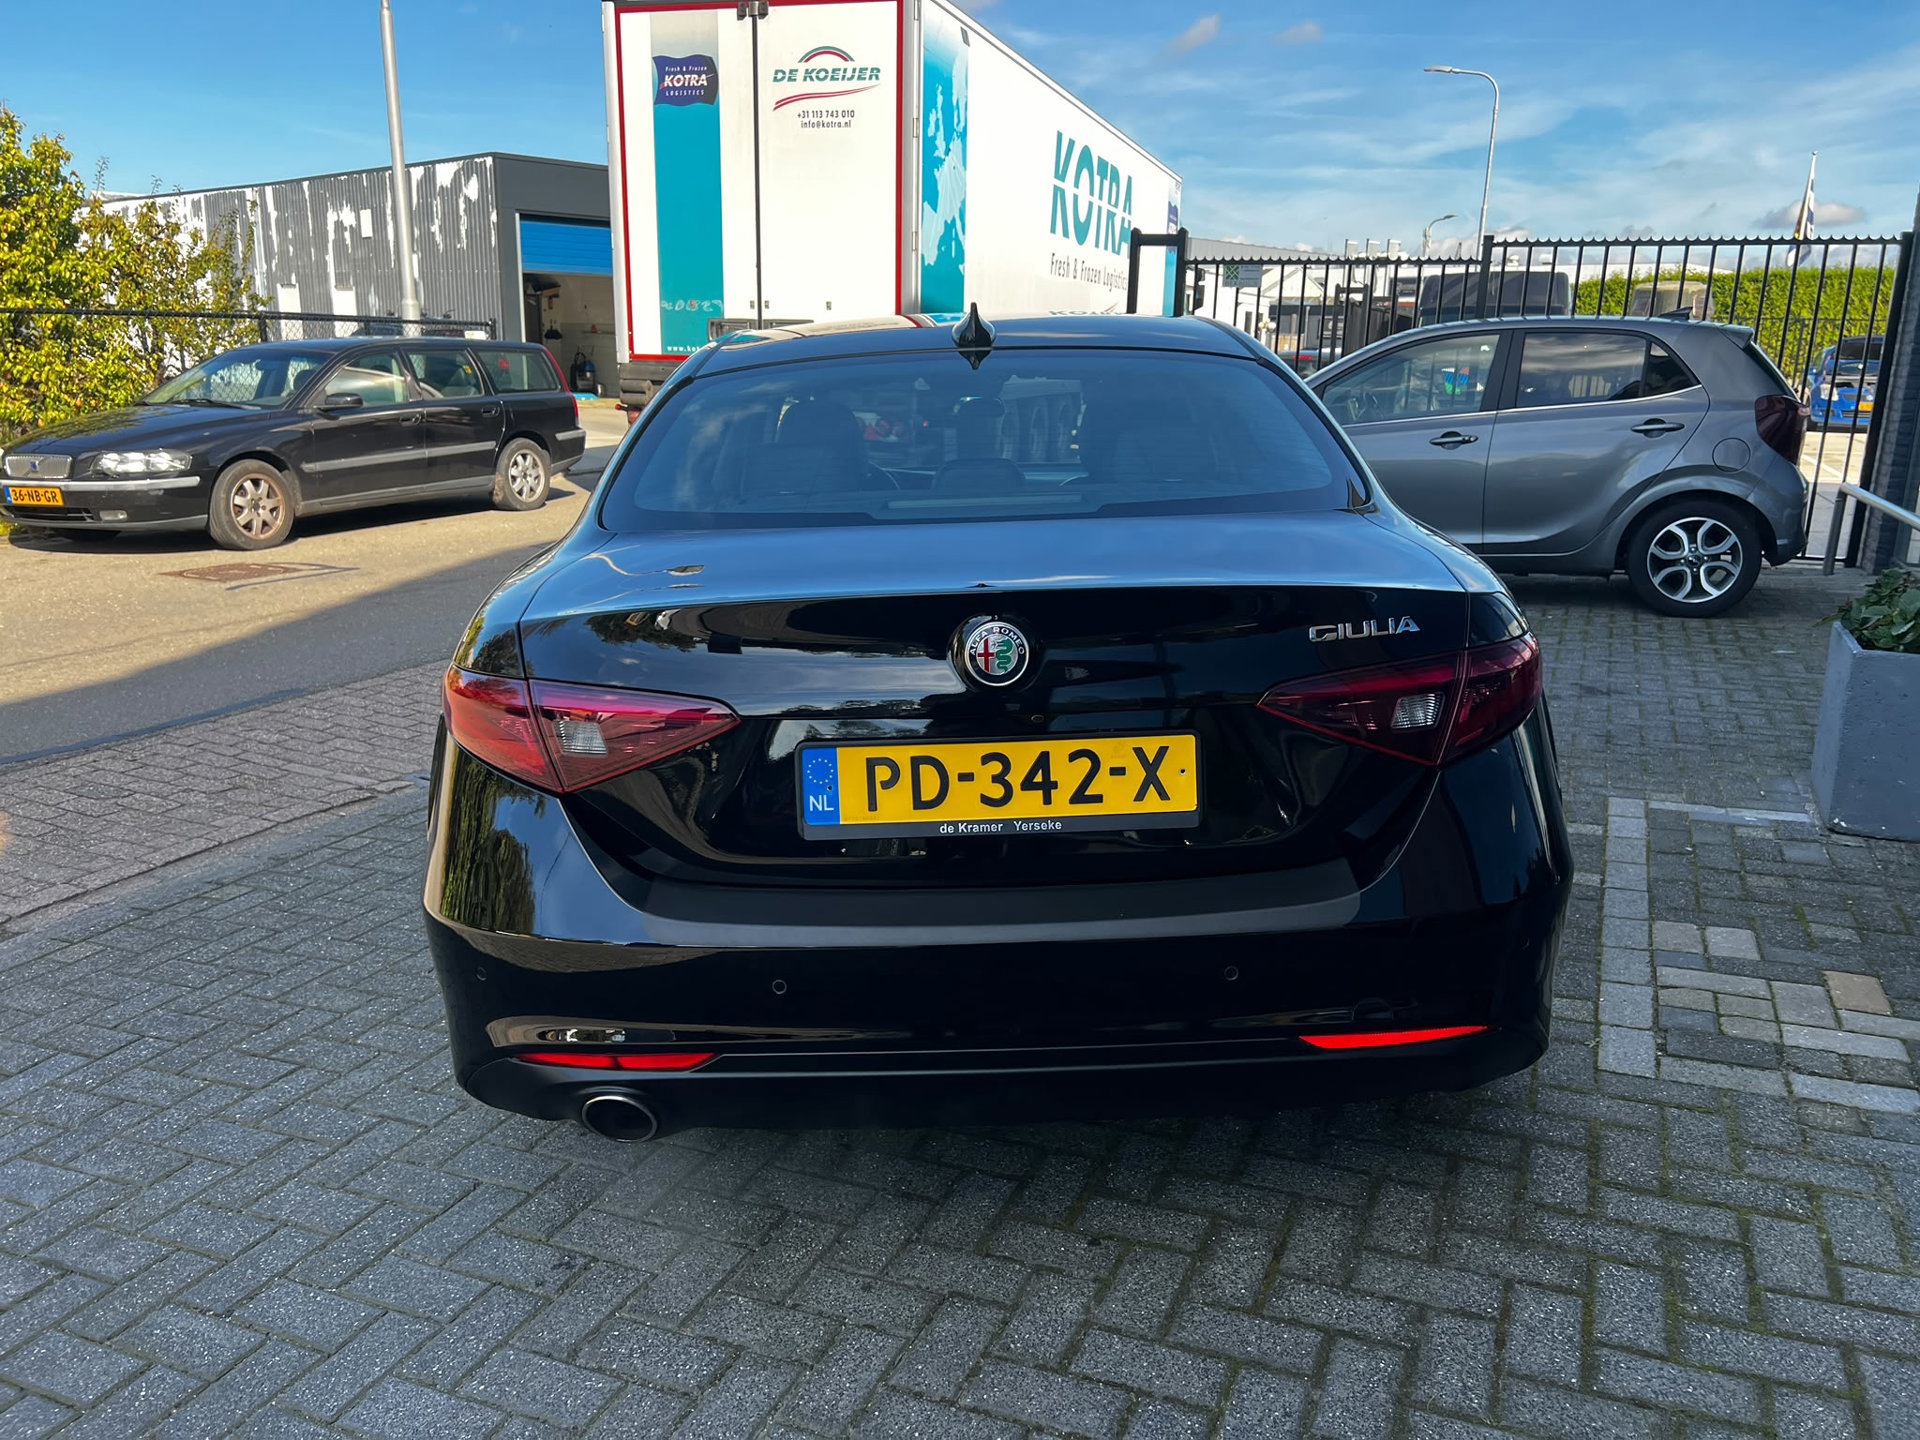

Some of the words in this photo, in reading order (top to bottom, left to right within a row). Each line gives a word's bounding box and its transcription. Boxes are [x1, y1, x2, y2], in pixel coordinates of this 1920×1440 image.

[664, 74, 708, 87] KOTRA
[773, 69, 797, 82] DE
[803, 67, 881, 82] KOEIJER
[797, 110, 809, 118] +31
[811, 110, 823, 118] 113
[825, 110, 839, 118] 743
[841, 109, 855, 118] 010
[800, 119, 851, 129] info@kotra.nl
[1050, 130, 1133, 259] KOTRA
[1050, 252, 1070, 278] Fresh
[1073, 258, 1078, 279] &
[1080, 260, 1101, 284] Frozen
[1103, 265, 1128, 292] Logistics
[12, 489, 59, 503] 36-NB-GR
[1309, 616, 1420, 642] GIULIA
[970, 630, 988, 655] ALFA
[992, 626, 1025, 655] ROMEO
[865, 745, 1171, 812] PD-342-X
[809, 795, 834, 812] NL
[939, 823, 955, 835] de
[958, 822, 1004, 834] Kramer
[1013, 819, 1063, 832] Yerseke
